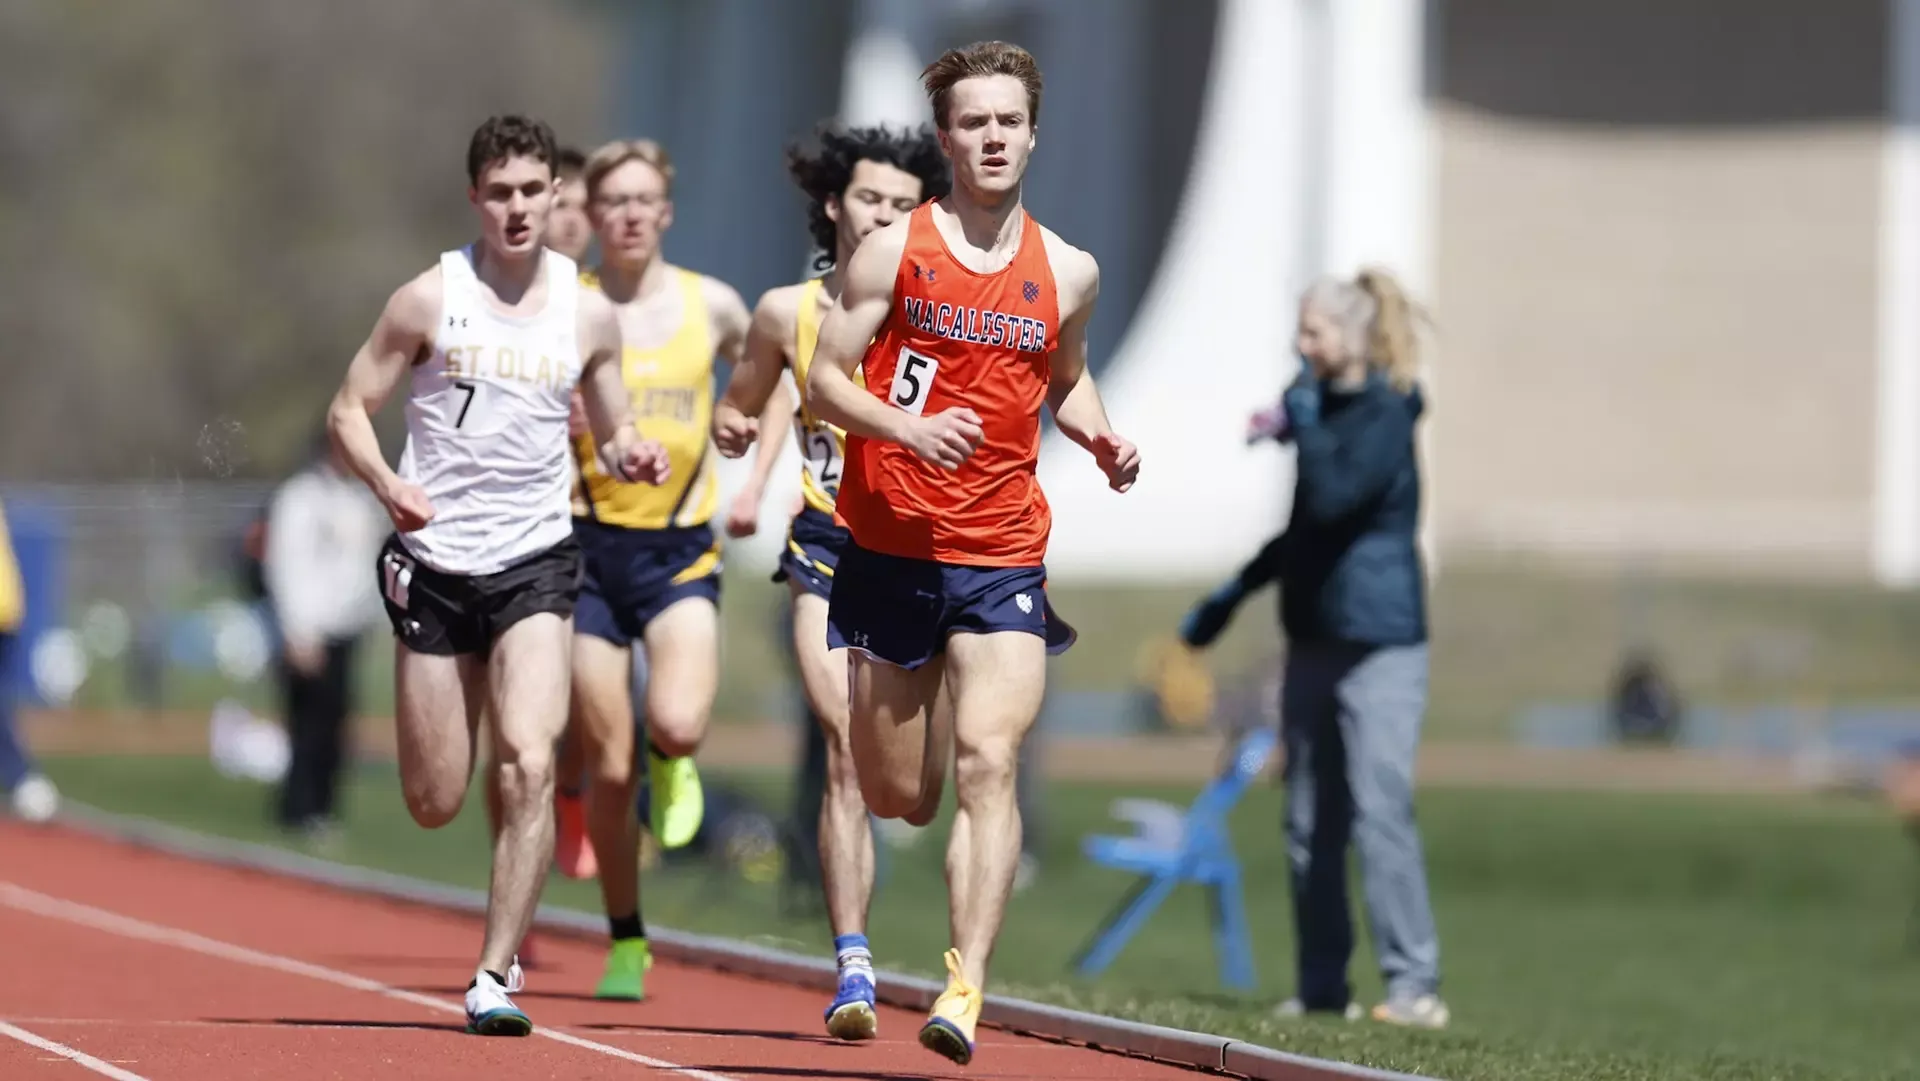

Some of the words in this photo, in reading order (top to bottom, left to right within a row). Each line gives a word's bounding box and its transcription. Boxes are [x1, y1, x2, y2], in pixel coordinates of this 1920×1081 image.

[904, 296, 1047, 354] MACALESTER
[454, 381, 476, 429] 7
[896, 354, 928, 407] 5
[813, 435, 839, 483] 2
